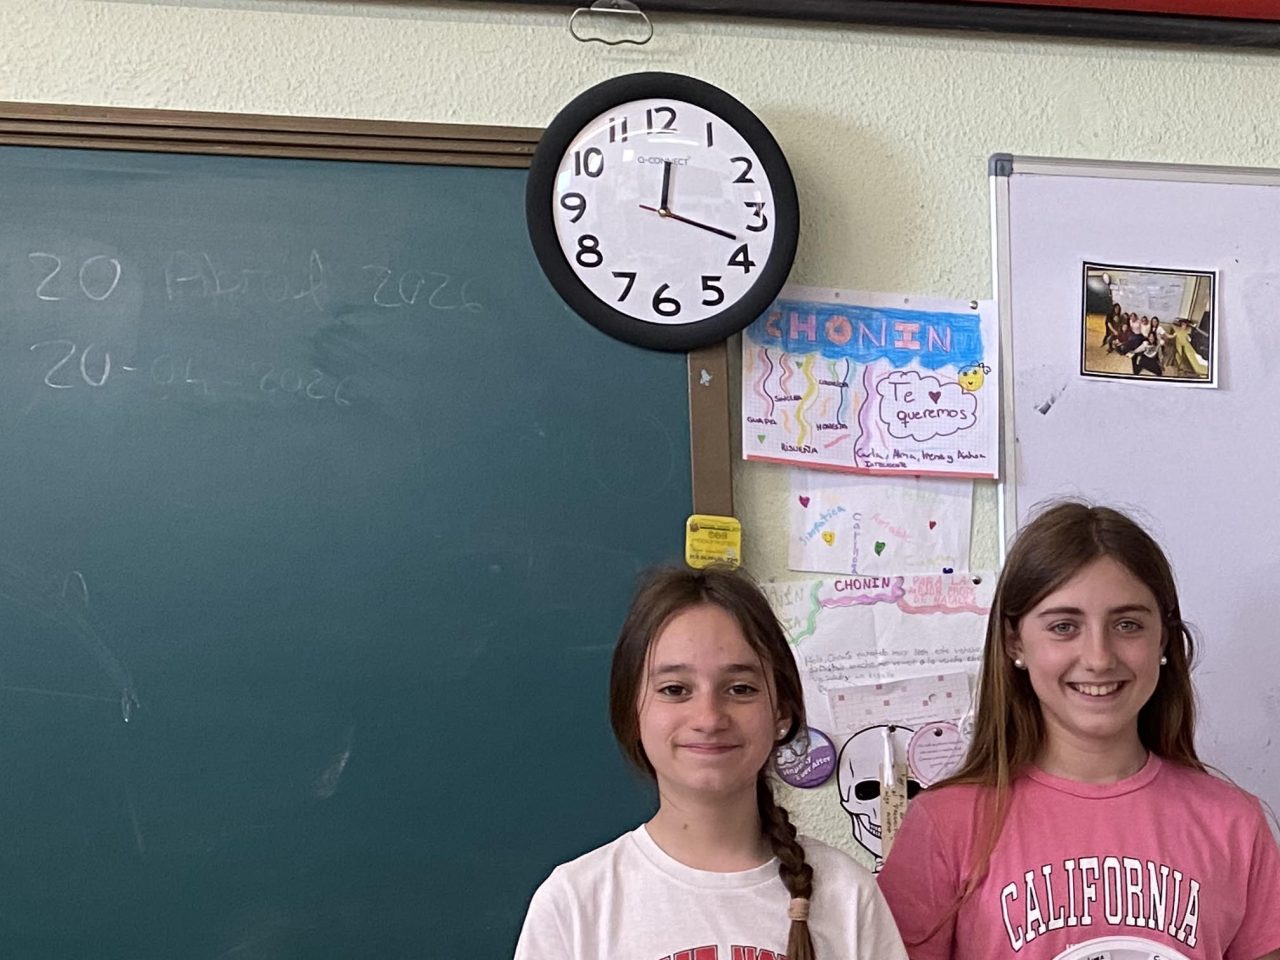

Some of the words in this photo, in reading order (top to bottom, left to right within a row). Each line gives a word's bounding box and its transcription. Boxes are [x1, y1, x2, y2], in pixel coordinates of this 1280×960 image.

[646, 106, 677, 135] 12
[706, 122, 714, 148] 1
[574, 147, 604, 177] 10
[730, 156, 755, 183] 2
[560, 192, 587, 224] 9
[743, 201, 768, 232] 3
[575, 234, 604, 268] 8
[727, 243, 756, 274] 4
[28, 252, 121, 301] 20
[611, 271, 637, 302] 7
[701, 275, 725, 306] 5
[651, 283, 682, 317] 6
[767, 311, 950, 352] CHONIN
[888, 382, 916, 404] Te
[897, 409, 968, 429] queremos
[834, 577, 891, 592] CHONIN
[1000, 856, 1201, 952] CALIFORNIA
